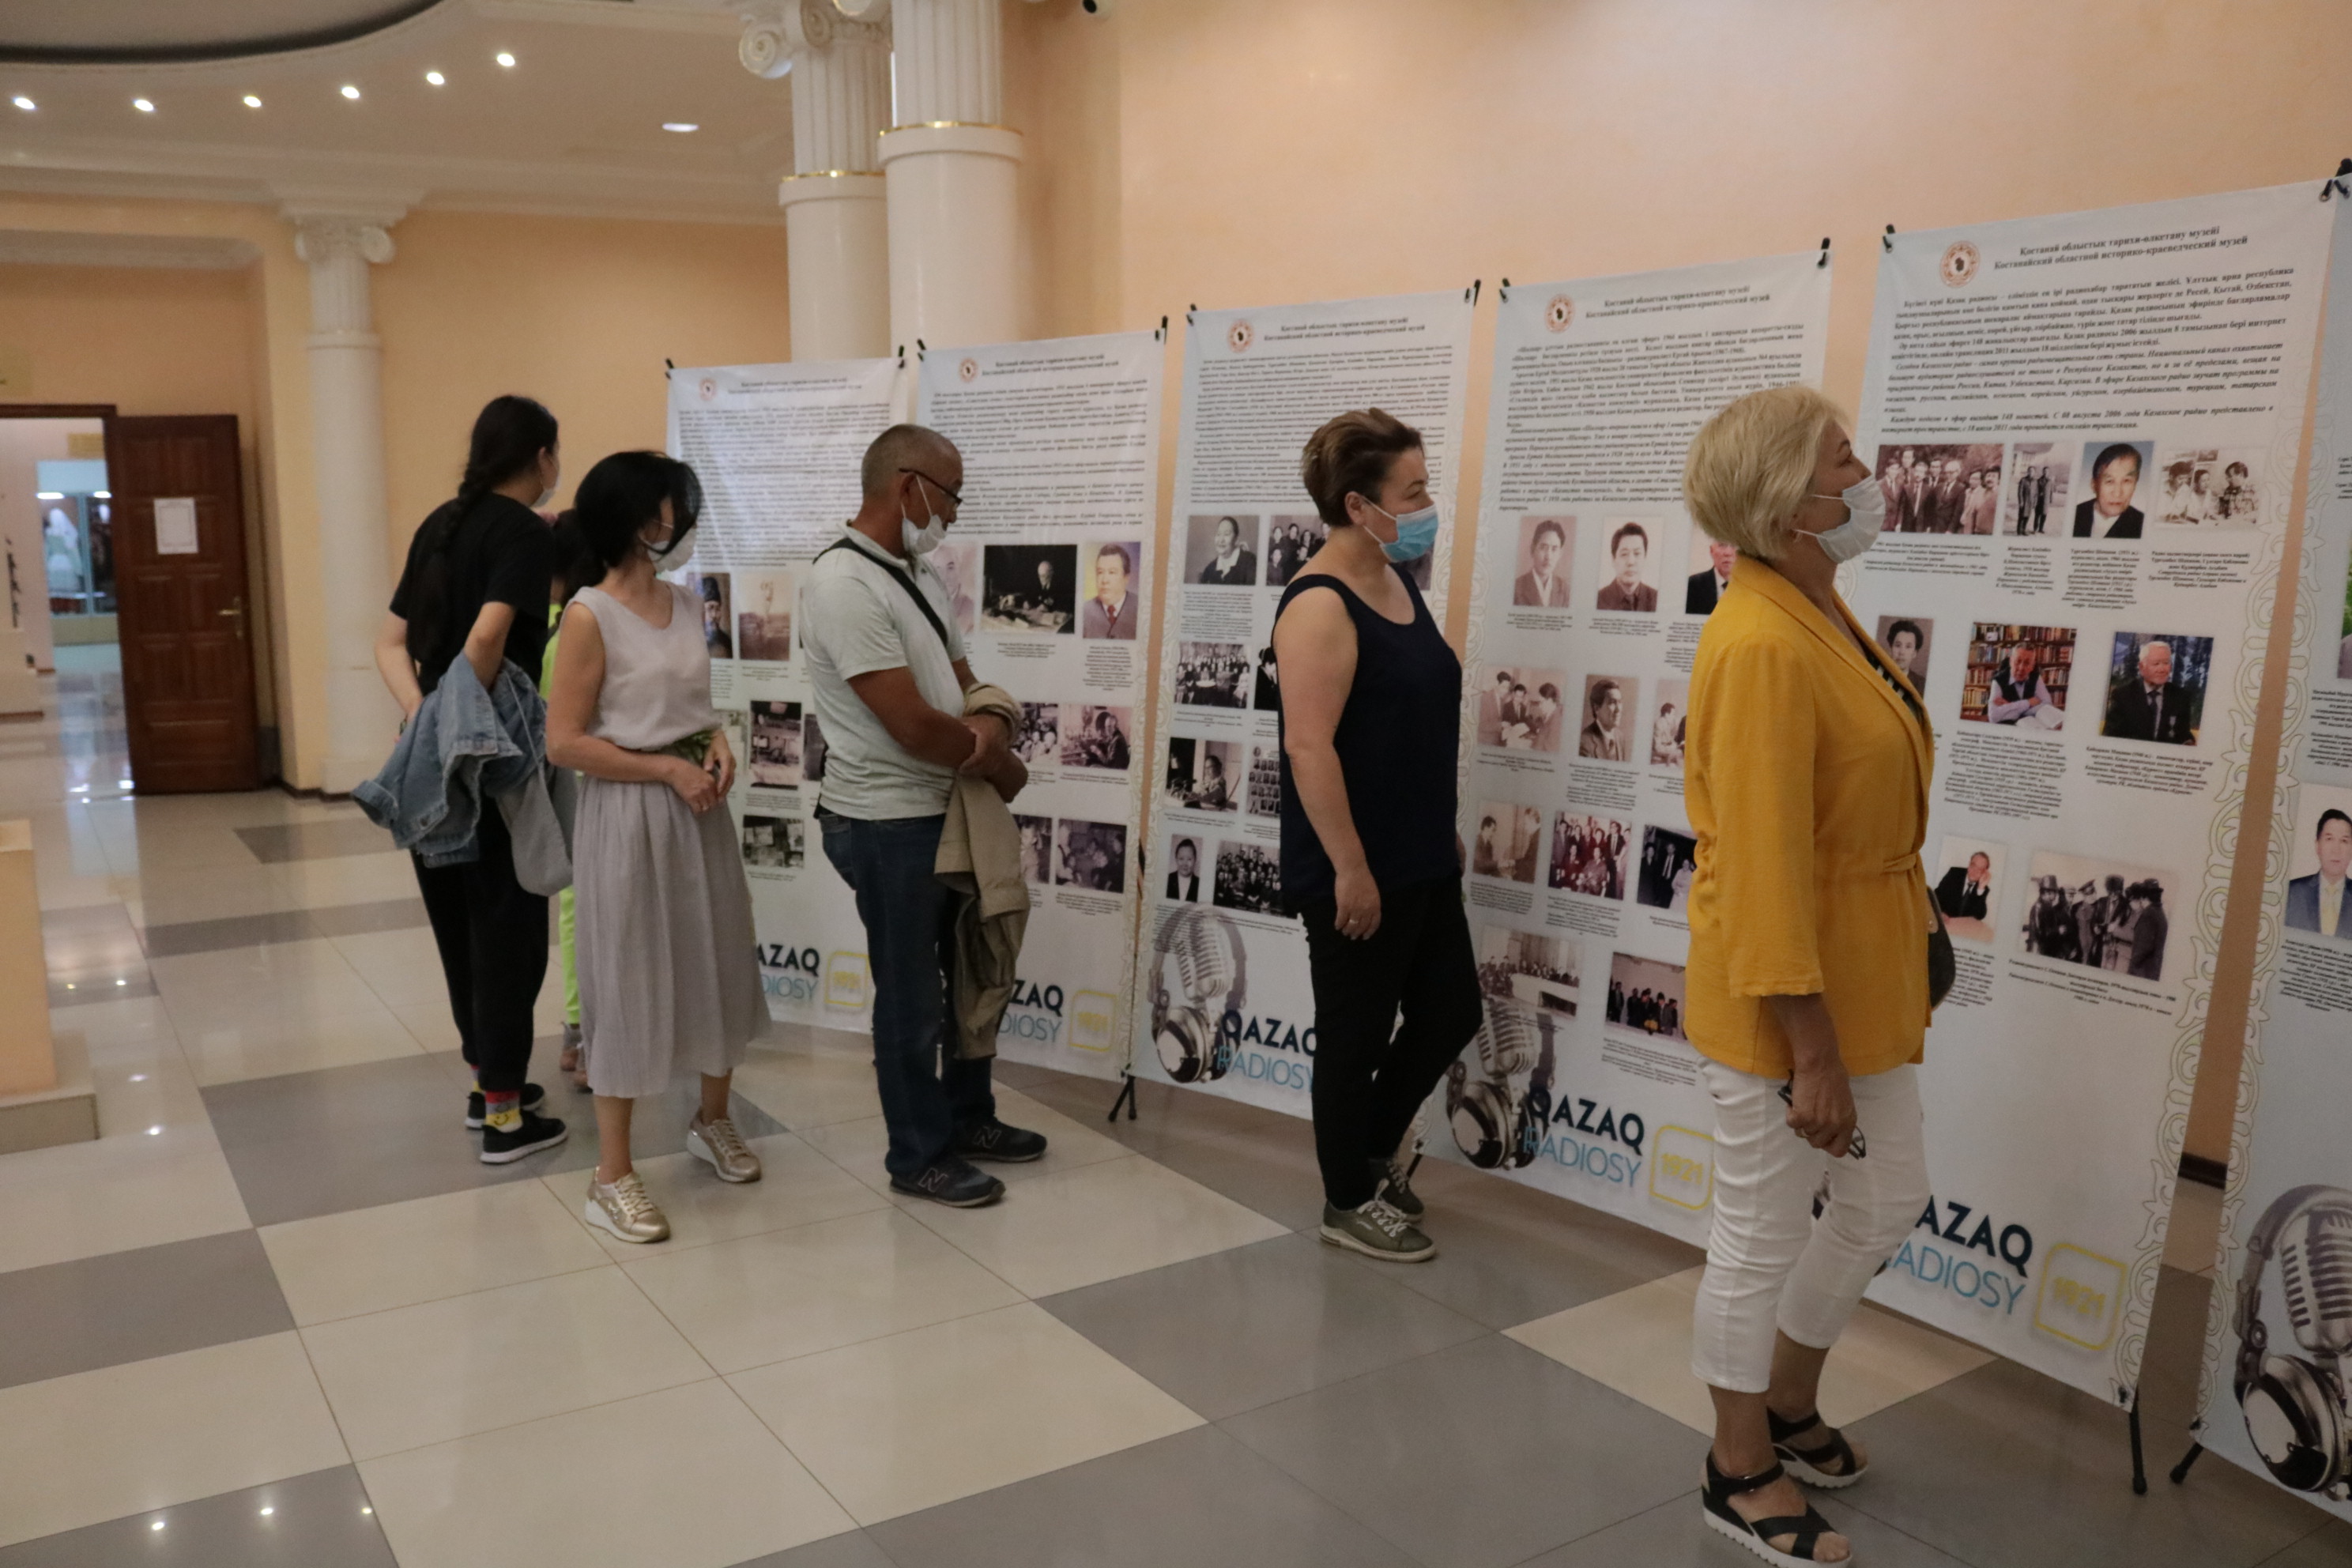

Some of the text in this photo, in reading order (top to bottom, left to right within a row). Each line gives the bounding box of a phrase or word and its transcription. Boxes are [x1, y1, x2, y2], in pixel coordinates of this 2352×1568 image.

[1529, 1087, 1644, 1156] QAZAQ
[1524, 1126, 1641, 1187] RADIOSY
[1661, 1152, 1703, 1184] 1921
[1915, 1195, 2033, 1279] AZAQ
[1890, 1240, 2026, 1315] ADIOSY
[2052, 1276, 2105, 1317] 1921
